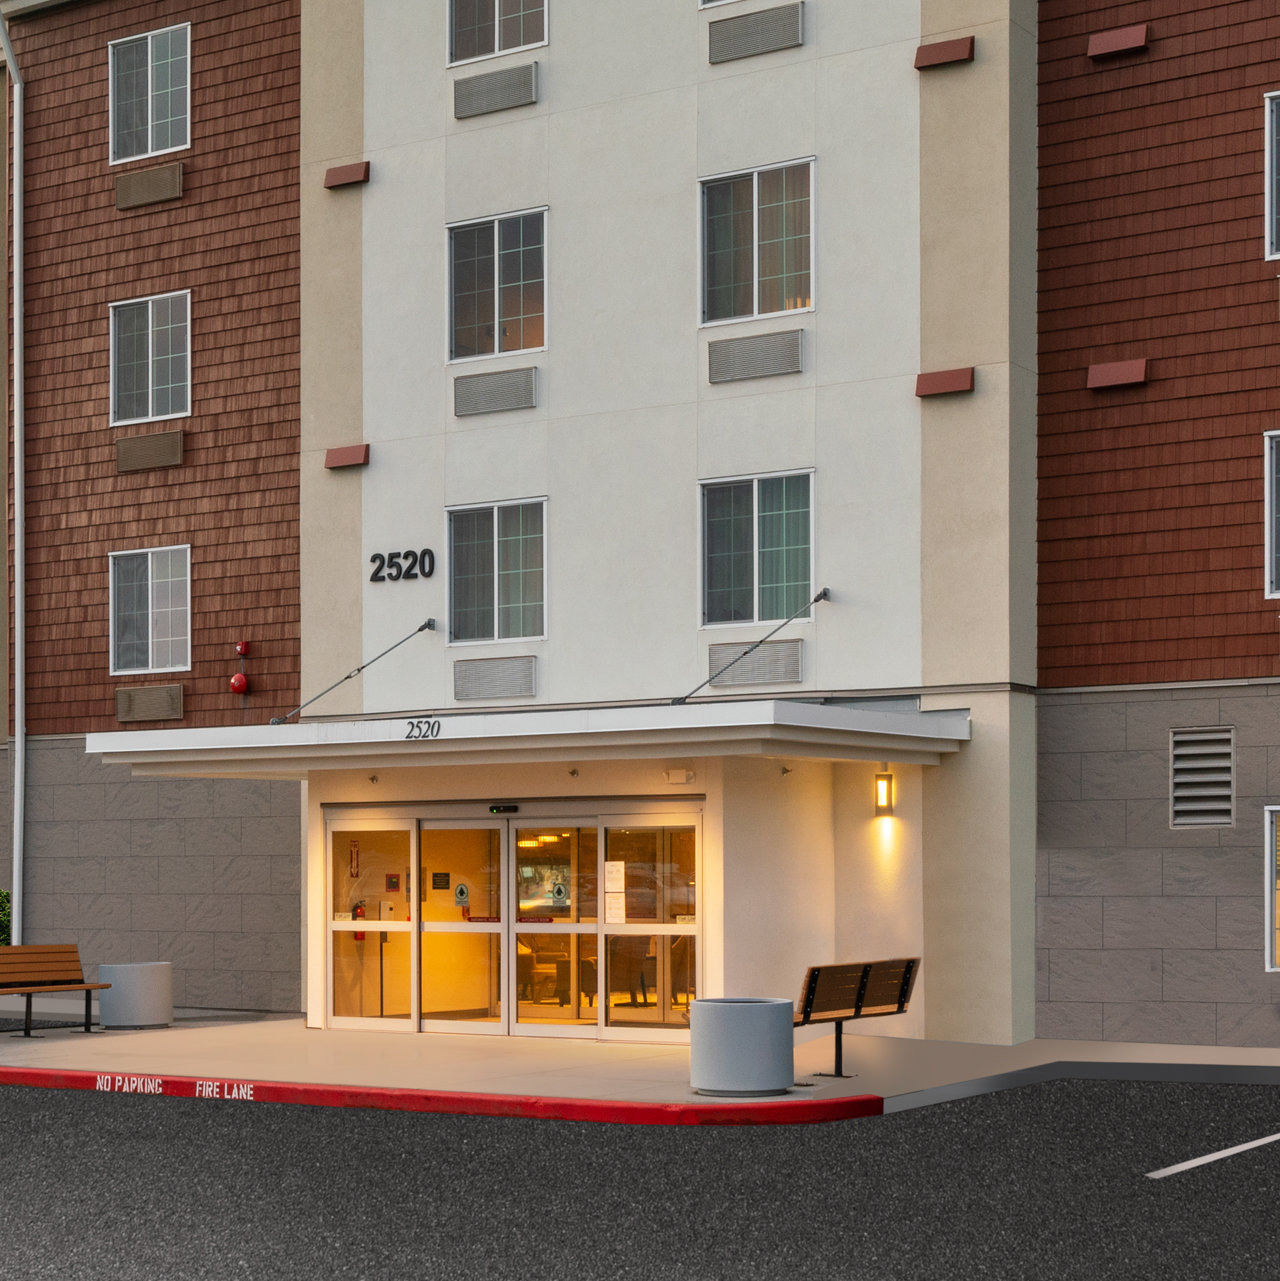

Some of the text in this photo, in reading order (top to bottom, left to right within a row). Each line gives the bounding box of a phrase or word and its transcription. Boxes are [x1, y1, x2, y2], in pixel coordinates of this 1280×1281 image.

[370, 548, 435, 582] 2520
[405, 720, 440, 739] 2520
[96, 1075, 254, 1100] NO PARKING FIRE LANE
